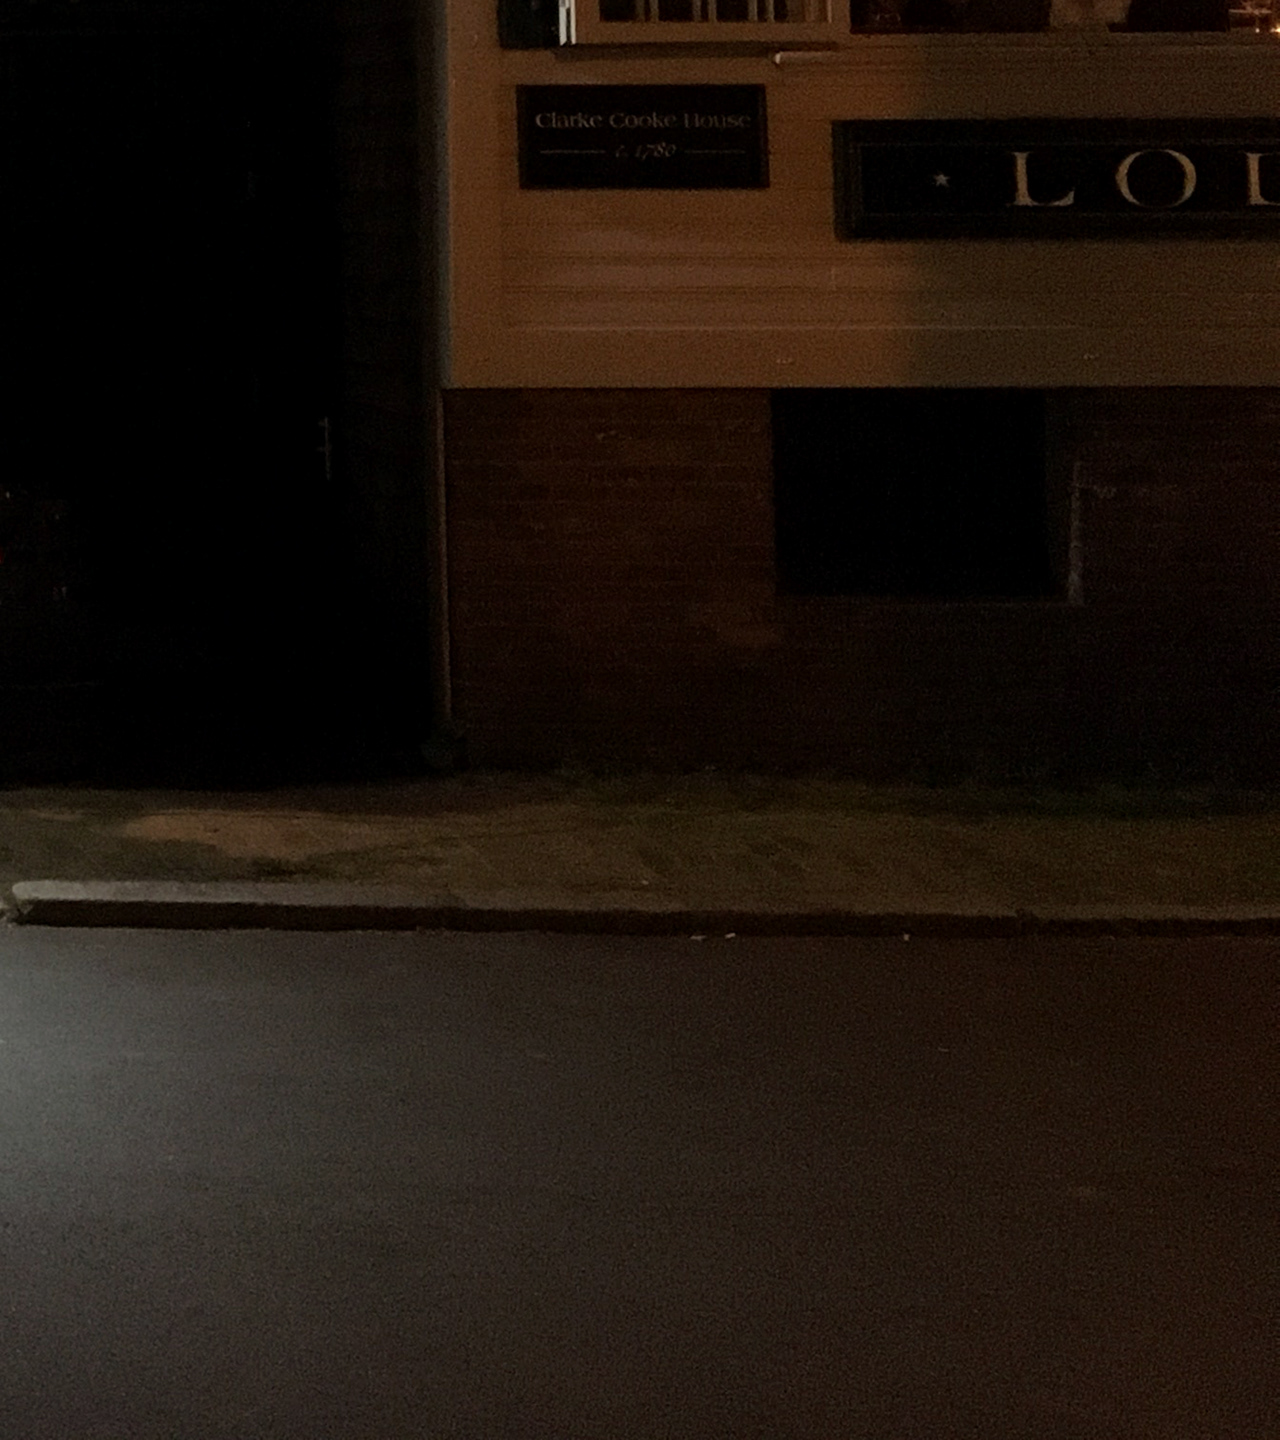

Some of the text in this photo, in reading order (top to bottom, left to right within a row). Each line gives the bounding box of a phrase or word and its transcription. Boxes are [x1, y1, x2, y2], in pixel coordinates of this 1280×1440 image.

[535, 112, 752, 129] Clarke Cooke House
